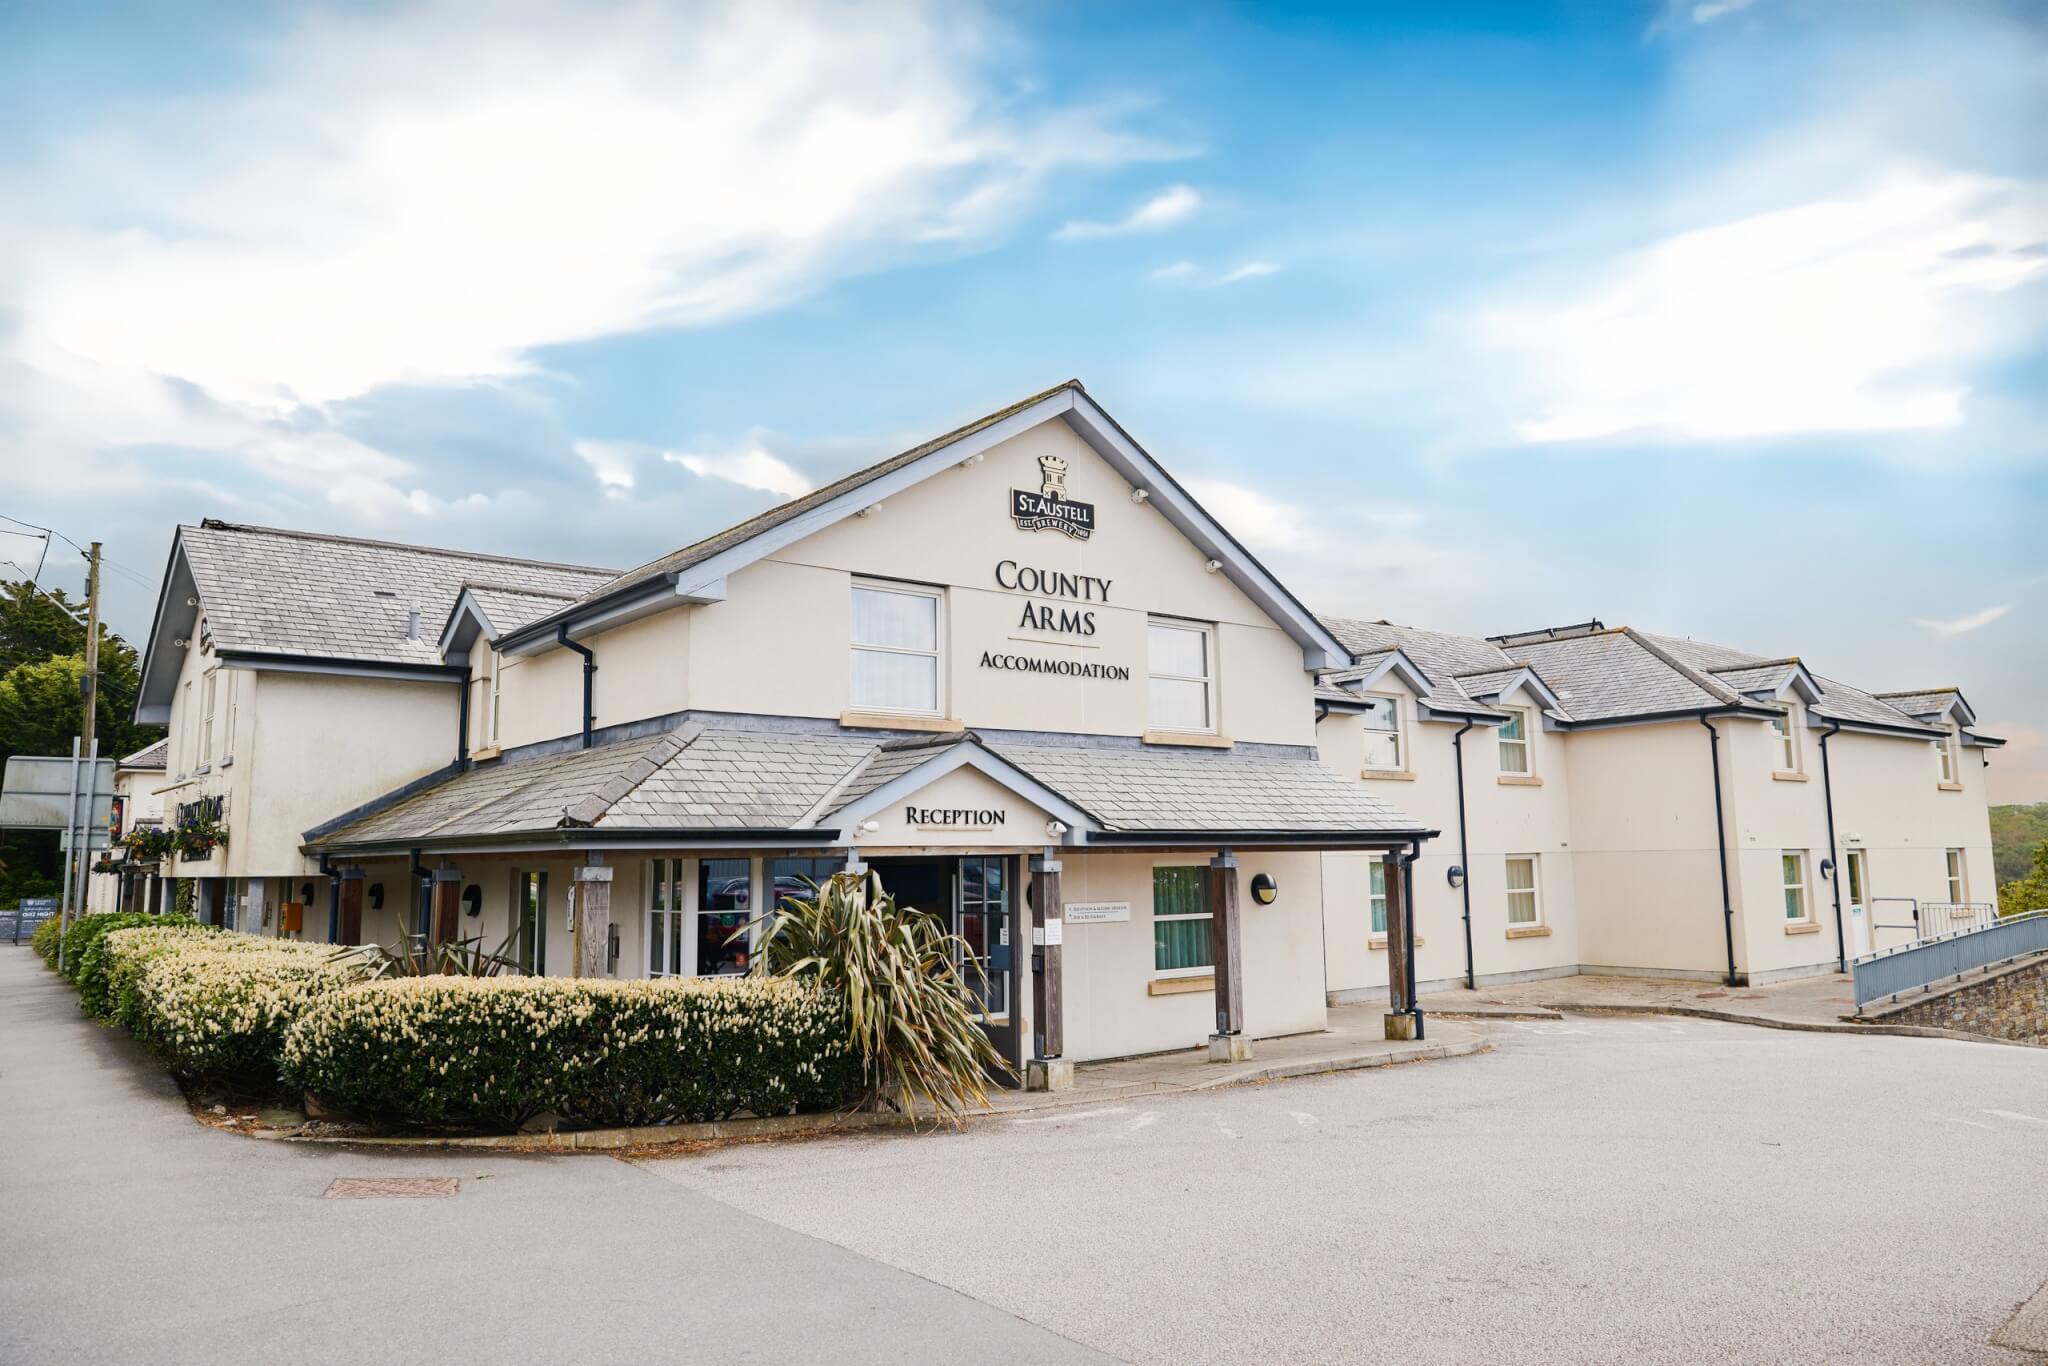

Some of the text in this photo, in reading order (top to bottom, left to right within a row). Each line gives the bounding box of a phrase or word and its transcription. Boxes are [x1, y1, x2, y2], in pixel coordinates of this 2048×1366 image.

[1036, 519, 1074, 534] BREWERY
[995, 560, 1112, 602] COUNTY
[1019, 600, 1096, 636] ARMS
[980, 651, 1130, 681] ACCOMMODATION
[905, 806, 1005, 825] RECEPTION
